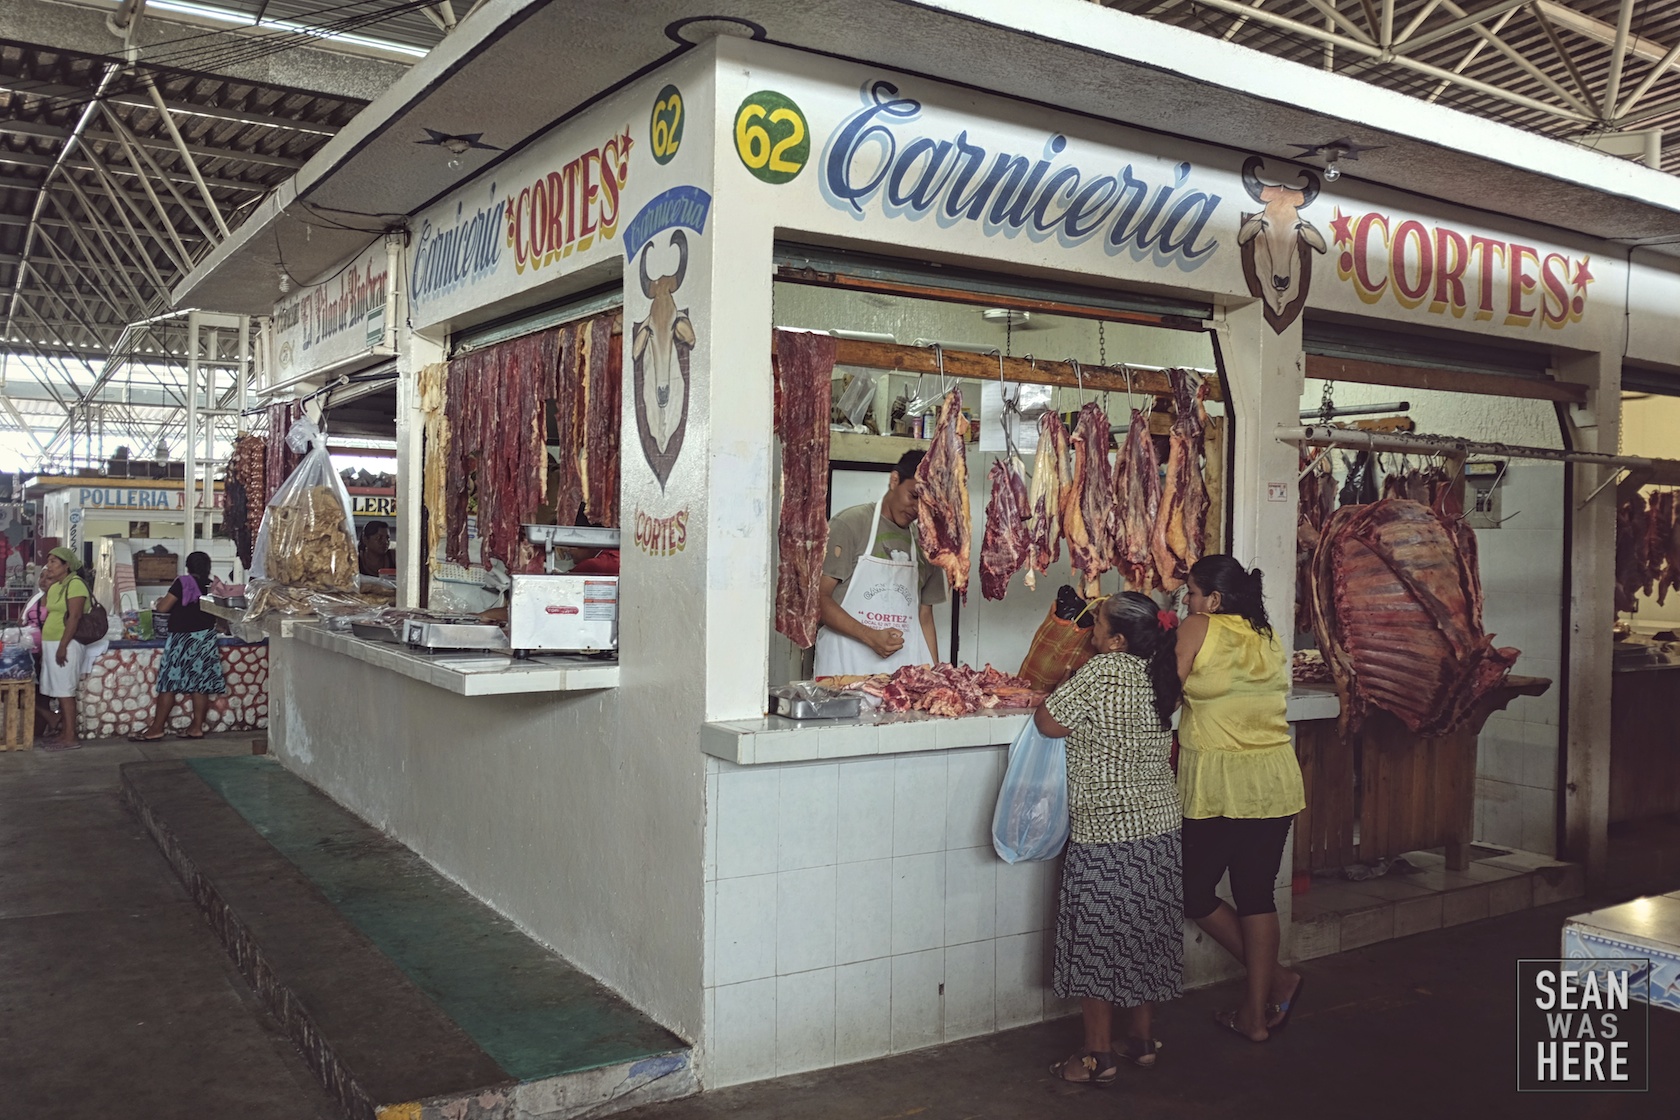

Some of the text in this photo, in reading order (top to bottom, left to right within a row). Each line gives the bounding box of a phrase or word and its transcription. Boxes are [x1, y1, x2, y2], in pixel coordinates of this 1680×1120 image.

[652, 94, 681, 158] 62
[735, 103, 804, 173] 62
[514, 136, 620, 276] CORTES
[1350, 211, 1571, 330] CORTES
[79, 487, 170, 509] POLLERIA
[634, 509, 688, 557] CORTES
